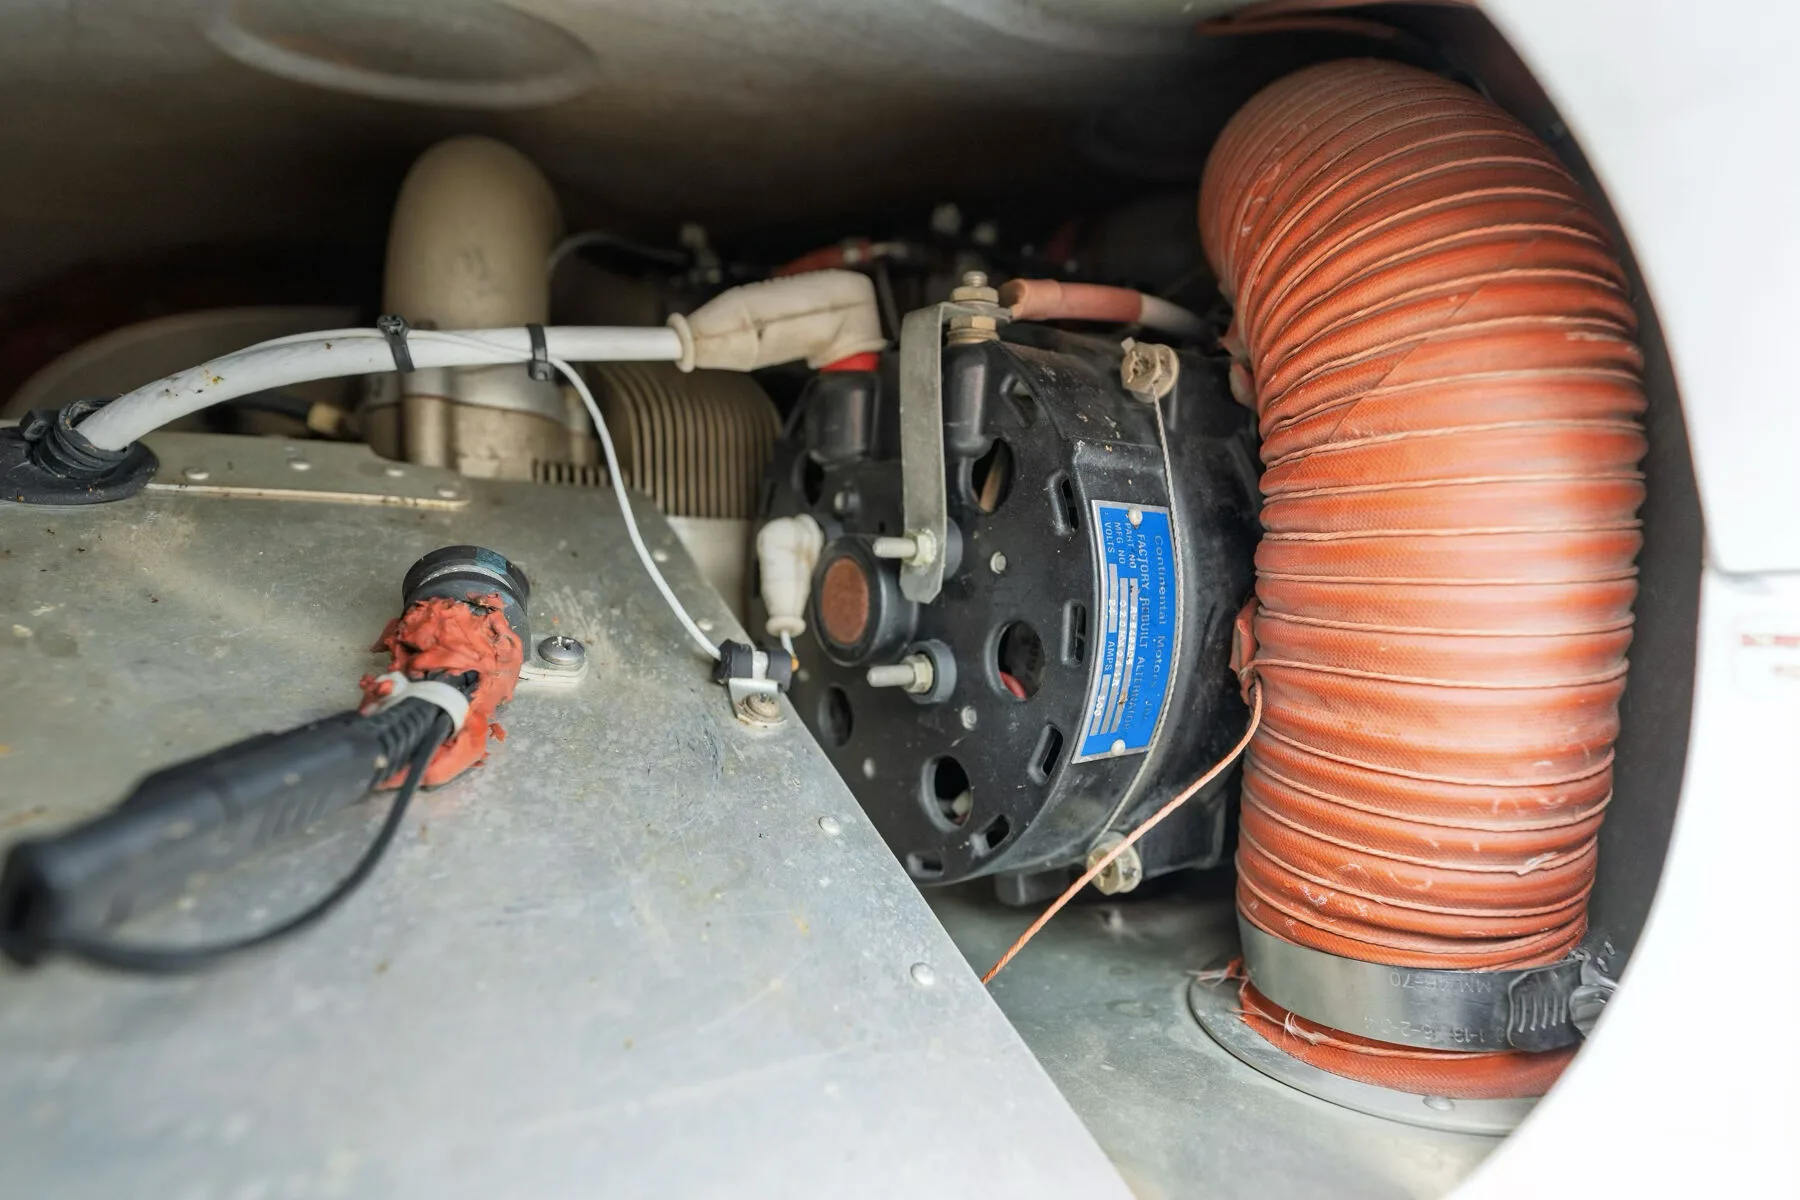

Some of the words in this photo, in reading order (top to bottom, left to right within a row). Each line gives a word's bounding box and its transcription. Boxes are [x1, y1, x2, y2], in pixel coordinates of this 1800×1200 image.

[1104, 521, 1115, 553] VOLTS
[1114, 521, 1123, 544] MFG
[1125, 522, 1134, 547] PART
[1118, 549, 1126, 565] NO
[1129, 554, 1137, 569] NO
[1137, 534, 1150, 589] FACTORY
[1154, 535, 1167, 624] Continental
[1139, 597, 1150, 648] REBUILT
[1105, 640, 1115, 671] AMPS
